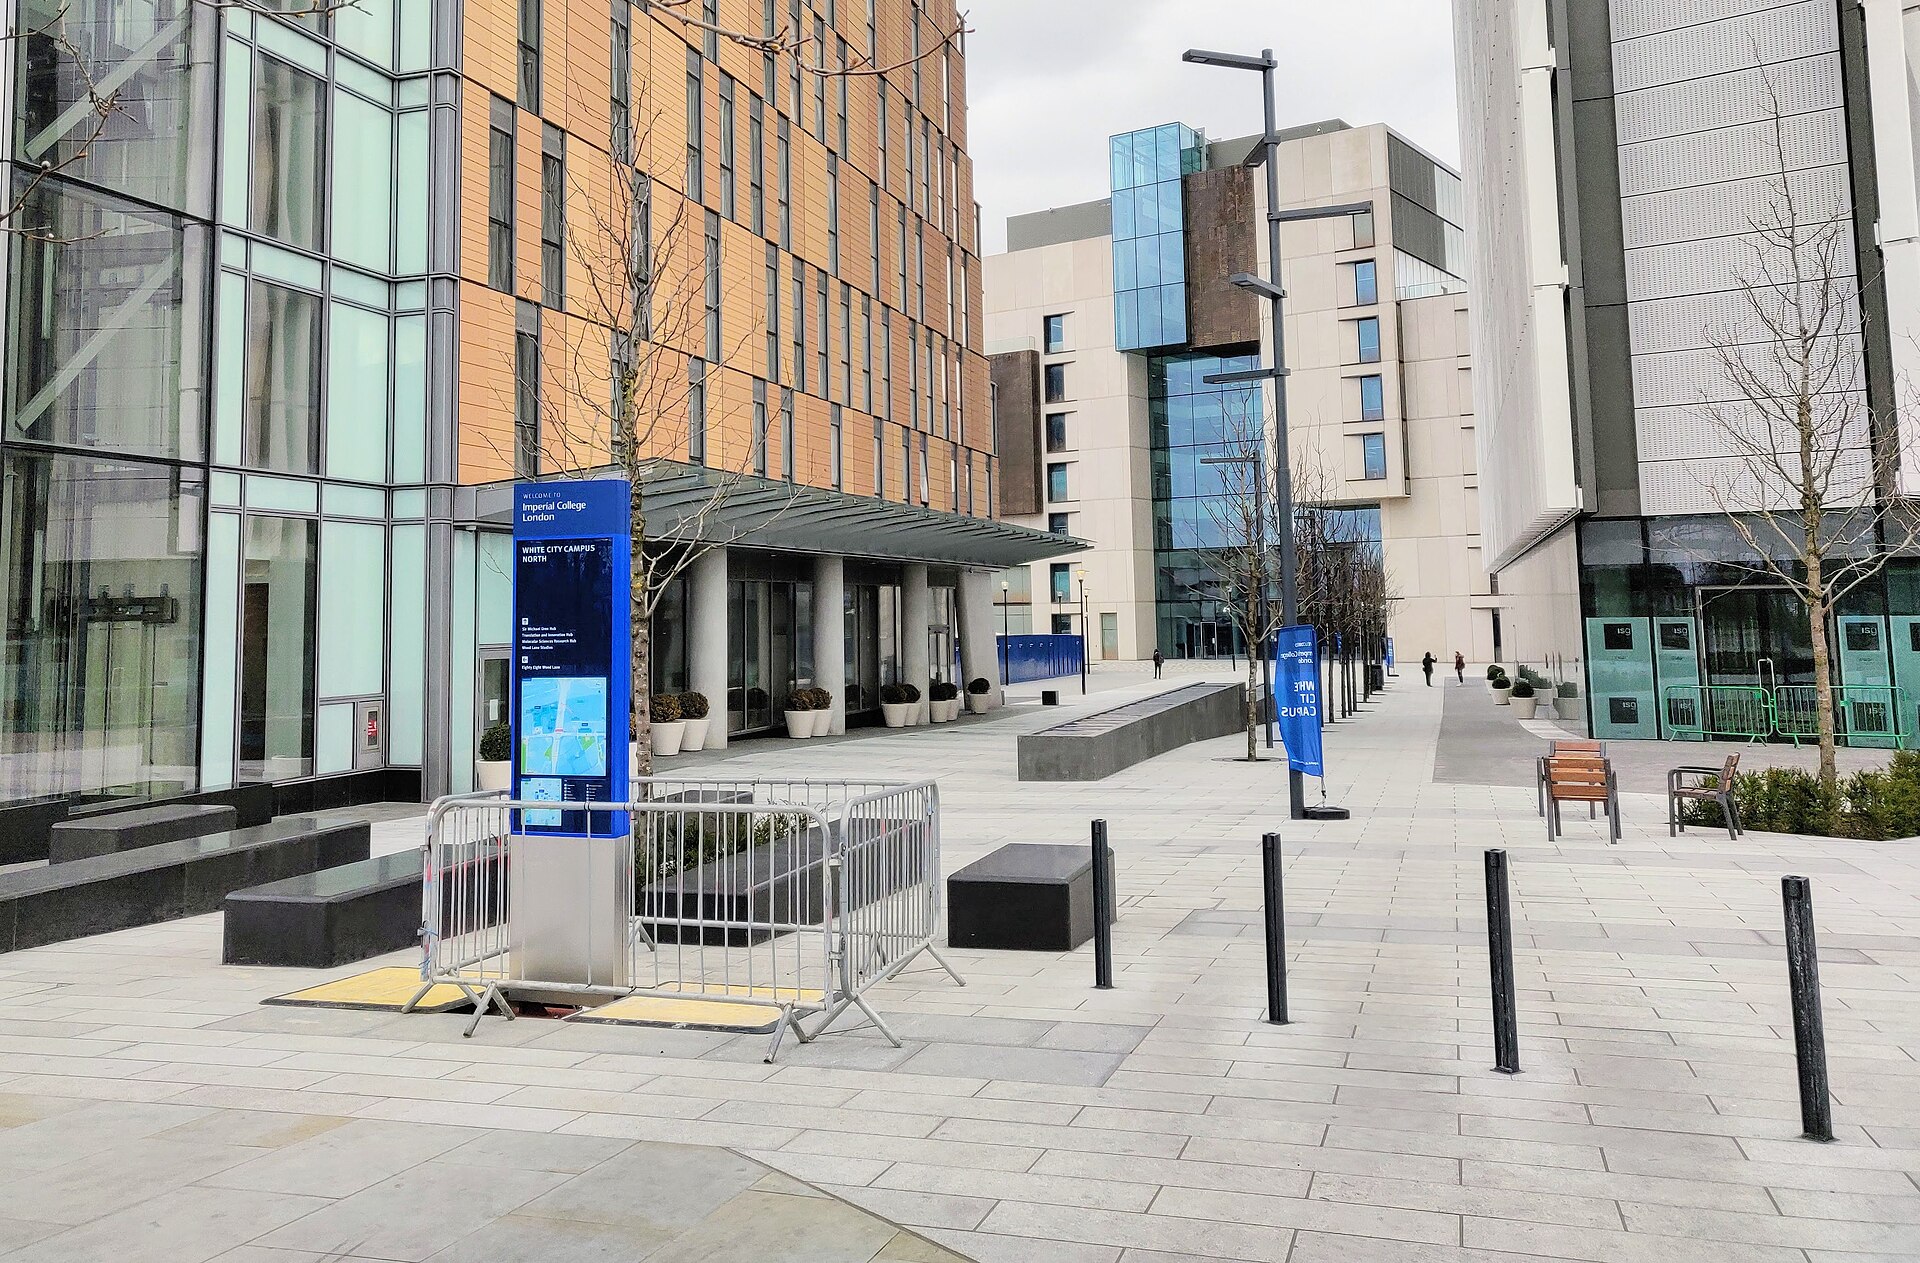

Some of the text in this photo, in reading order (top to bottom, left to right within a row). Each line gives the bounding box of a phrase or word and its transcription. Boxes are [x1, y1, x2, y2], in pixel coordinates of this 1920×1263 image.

[522, 501, 586, 513] Imperial College
[522, 513, 555, 522] London
